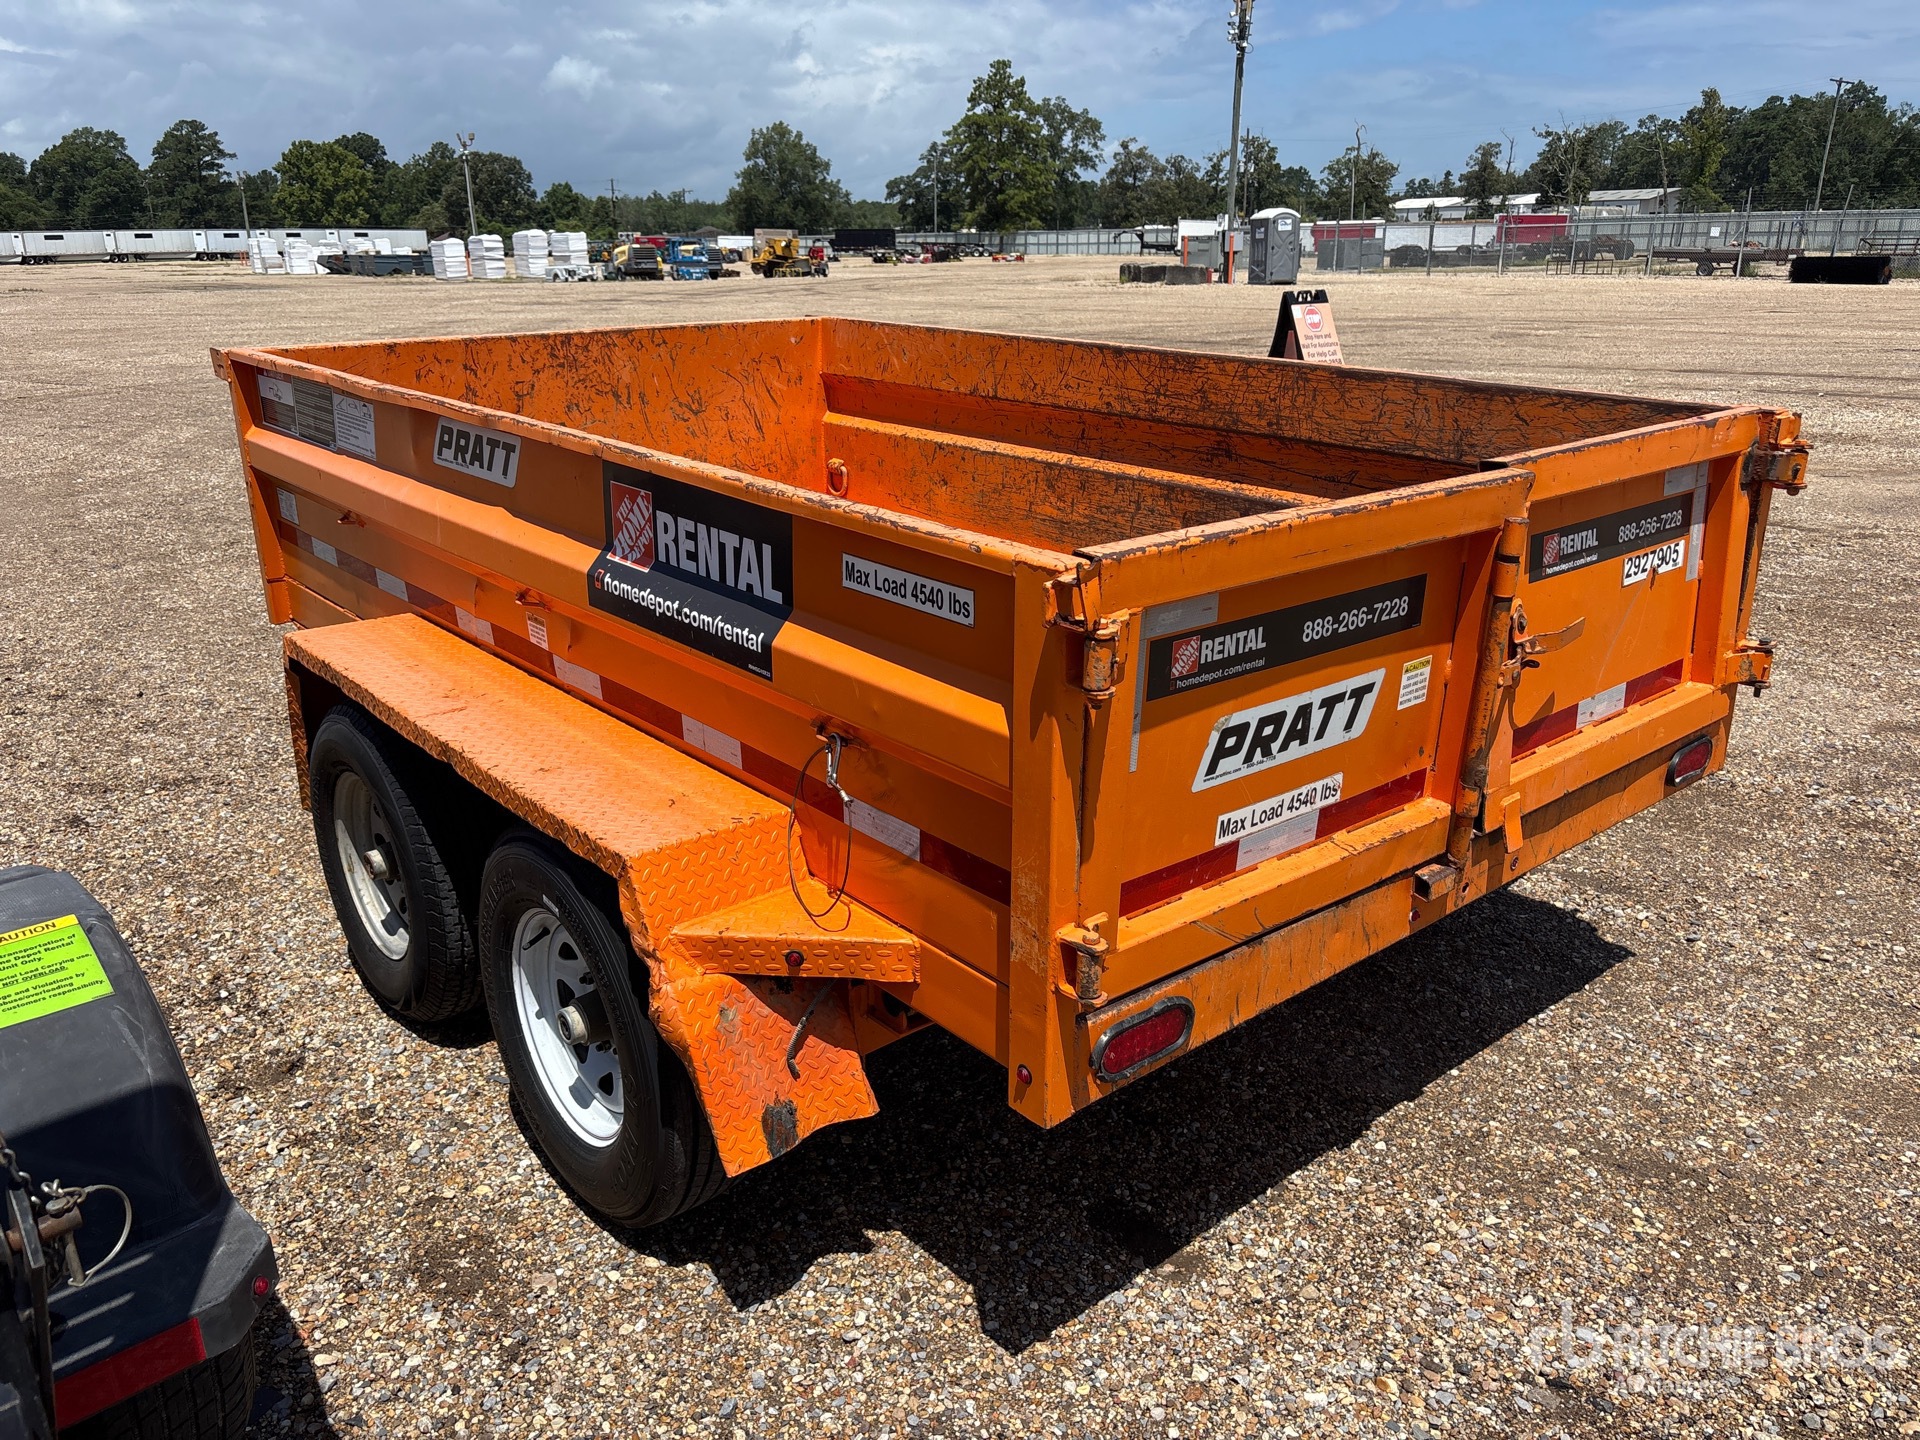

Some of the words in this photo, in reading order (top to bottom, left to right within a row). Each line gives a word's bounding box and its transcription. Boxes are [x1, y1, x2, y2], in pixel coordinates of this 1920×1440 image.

[1316, 350, 1327, 358] Help
[437, 424, 517, 477] PRATT
[614, 490, 652, 558] HOME
[616, 494, 633, 523] THE
[628, 522, 653, 561] DEPOT
[1560, 528, 1599, 556] RENTAL
[1618, 509, 1683, 543] 888-266-7228
[655, 510, 783, 605] RENTAL
[1625, 543, 1680, 579] 2927905
[845, 560, 870, 588] Max
[874, 569, 907, 599] Load
[911, 581, 944, 610] 4540
[948, 591, 970, 618] lbs
[604, 572, 765, 653] homedepot.com/rental
[1302, 595, 1409, 643] 888-266-7228
[1171, 637, 1200, 677] HOME
[1200, 626, 1267, 664] RENTAL
[1176, 657, 1266, 689] homedepot.com/rental
[1410, 659, 1431, 671] CAUTION
[1204, 682, 1376, 777] PRATT
[1218, 816, 1248, 840] Max
[1250, 799, 1285, 827] Load
[1286, 787, 1318, 813] 4540
[1320, 782, 1339, 801] lbs
[0, 922, 56, 944] AUTION
[0, 937, 65, 959] transportation
[14, 950, 42, 961] Depot
[44, 940, 74, 952] Rental
[20, 957, 44, 966] Only.
[0, 973, 17, 982] erial
[19, 967, 39, 977] Load
[41, 957, 75, 971] Carrying
[2, 979, 19, 987] NOT
[14, 987, 30, 996] and
[31, 976, 74, 990] Violations
[2, 996, 47, 1012] customers
[48, 980, 105, 999] responsibility.
